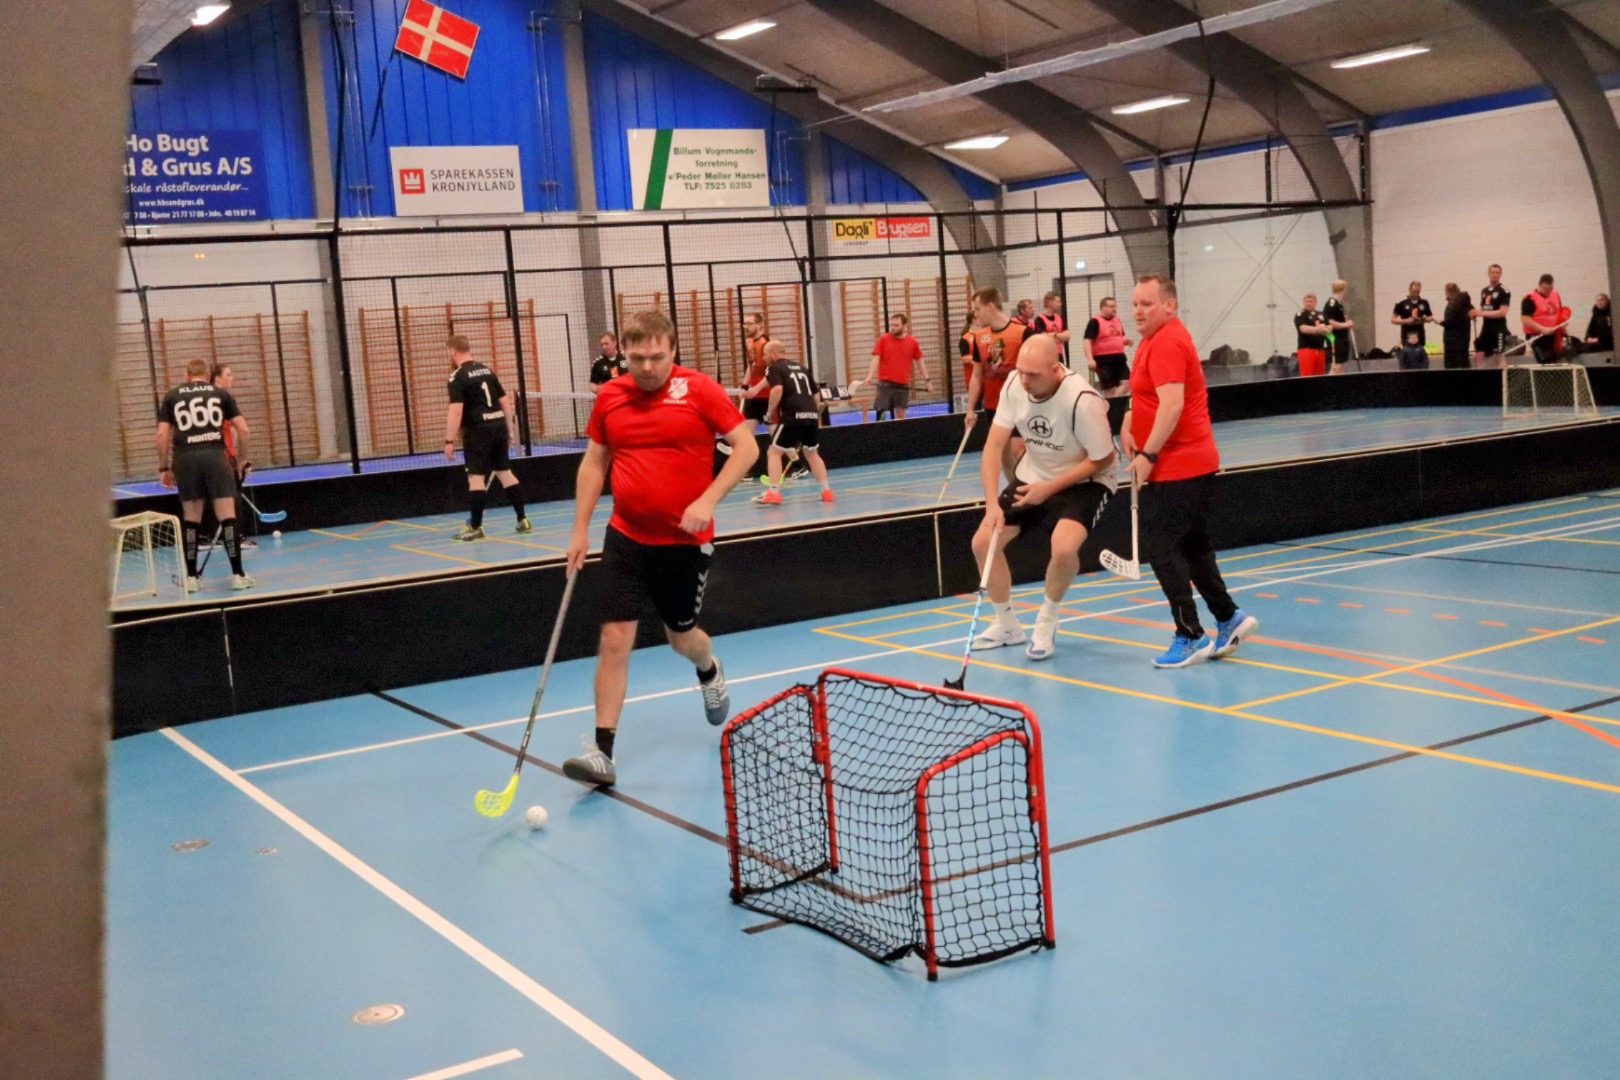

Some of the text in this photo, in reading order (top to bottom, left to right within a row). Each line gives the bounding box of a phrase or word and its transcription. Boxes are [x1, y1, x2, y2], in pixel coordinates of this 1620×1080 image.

[156, 133, 210, 157] Bugt
[673, 147, 757, 156] Billum Vognmands-
[140, 157, 159, 176] &
[162, 157, 213, 176] Grus
[217, 156, 253, 175] A/S
[695, 160, 738, 168] forretning
[430, 168, 514, 180] SPAREKASSEN
[734, 172, 766, 180] Hansen
[432, 181, 516, 192] KRONJYLLAND
[684, 182, 702, 190] TLF:
[704, 182, 727, 190] 7525
[877, 220, 928, 237] Brugsen
[179, 385, 214, 394] KLAUS
[789, 372, 812, 395] 17
[481, 381, 492, 407] 1
[174, 397, 223, 431] 666
